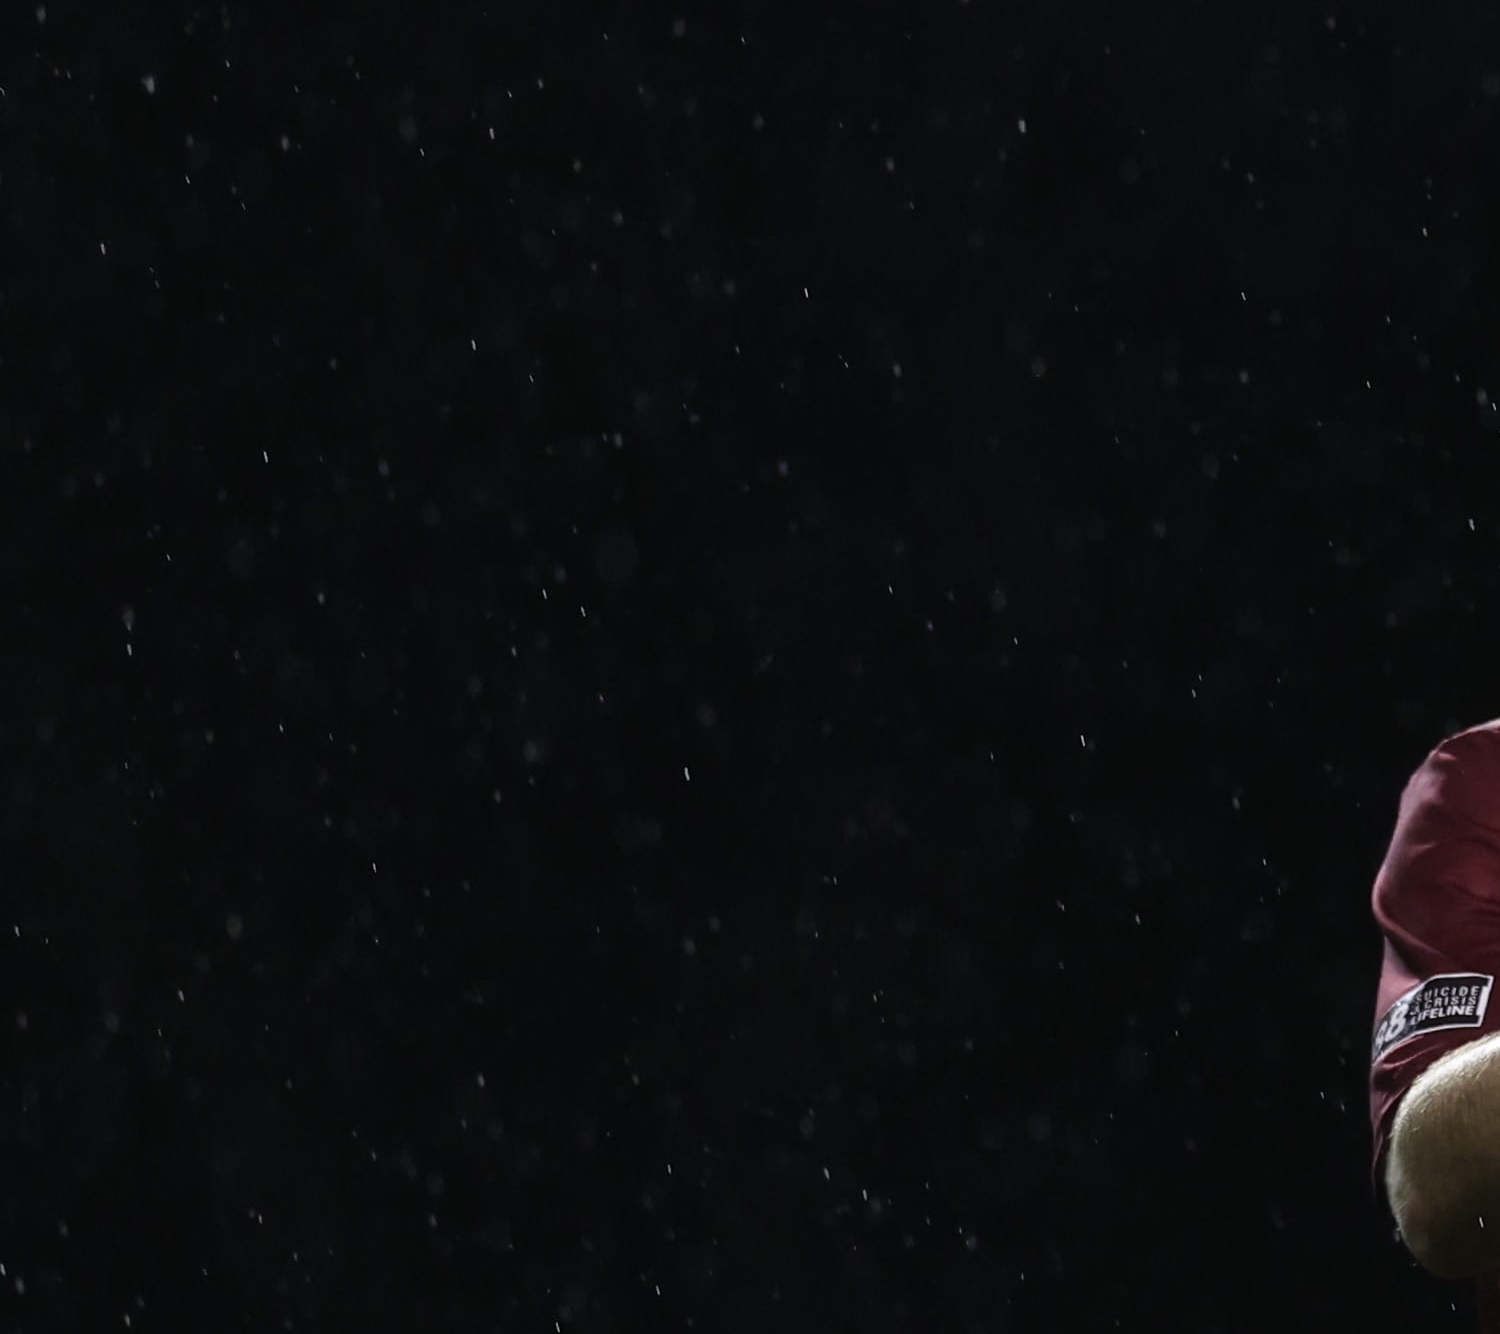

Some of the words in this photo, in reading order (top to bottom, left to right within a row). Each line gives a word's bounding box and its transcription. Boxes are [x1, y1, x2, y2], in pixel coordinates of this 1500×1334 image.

[1414, 985, 1480, 1003] SUICIDE
[1424, 996, 1477, 1009] CRISIS
[1409, 1005, 1476, 1026] LIFELINE
